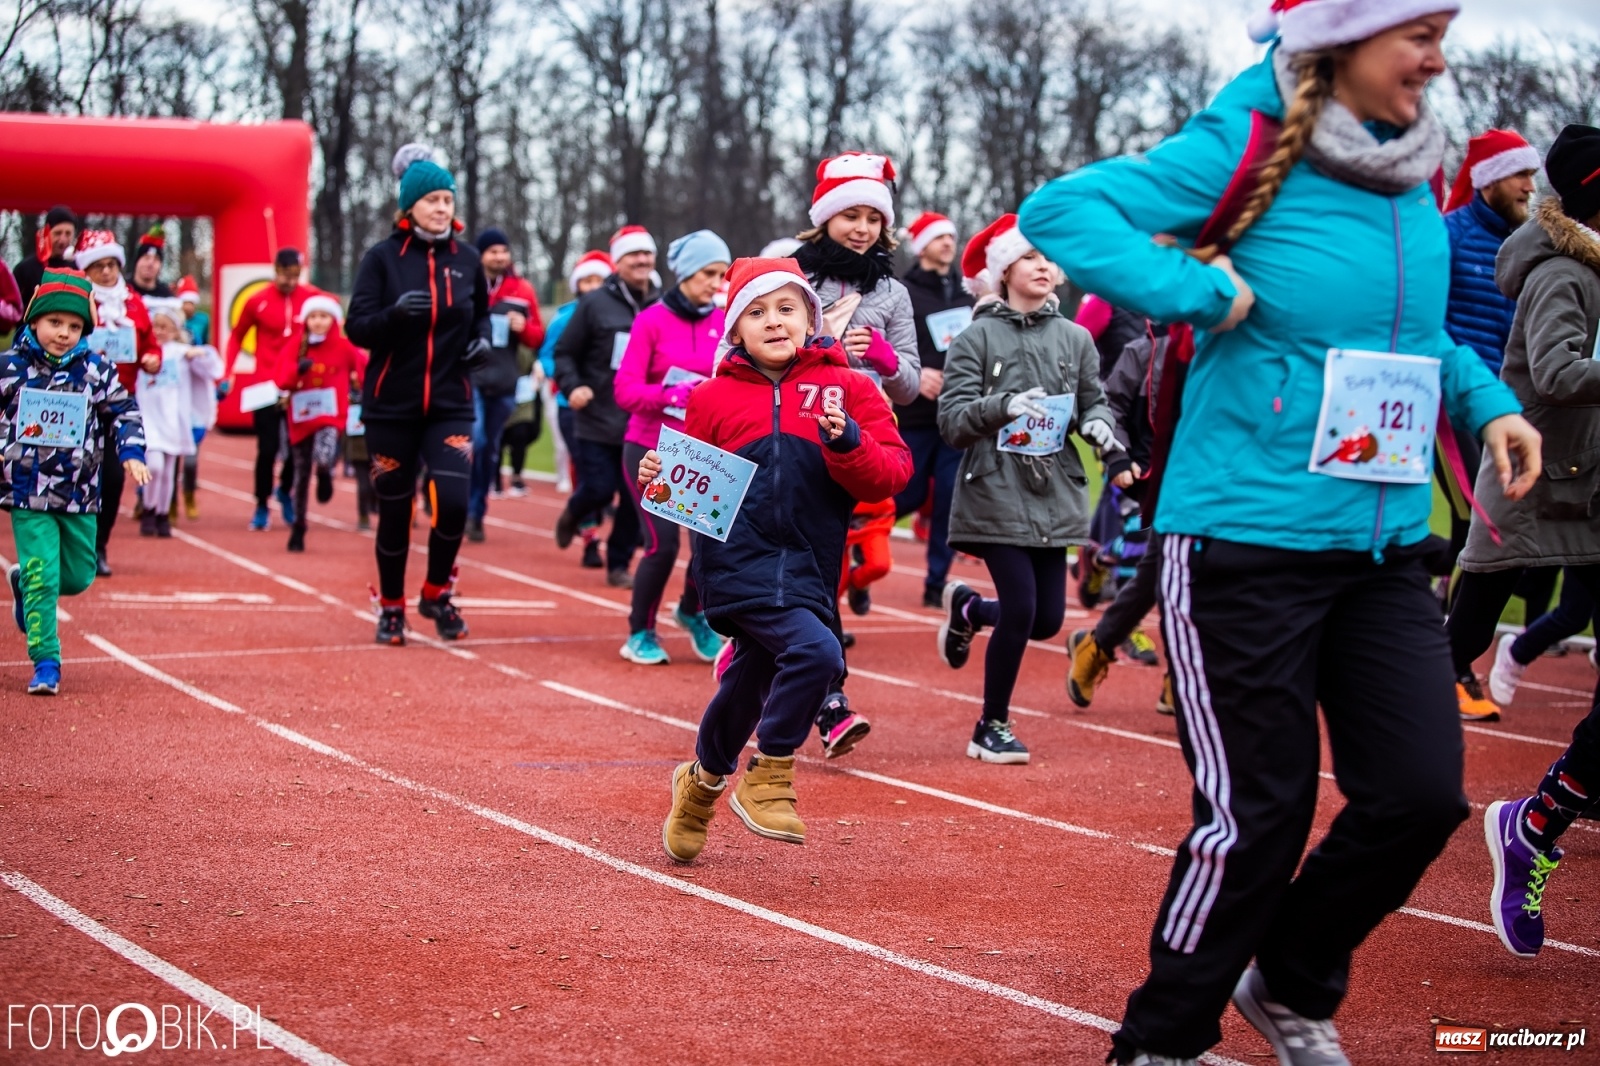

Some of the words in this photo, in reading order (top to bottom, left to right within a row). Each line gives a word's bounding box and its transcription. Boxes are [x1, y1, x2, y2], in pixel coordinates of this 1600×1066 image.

[797, 383, 845, 411] 78
[40, 409, 65, 425] 021
[1026, 416, 1055, 431] 046
[1379, 400, 1414, 431] 121
[670, 464, 711, 495] 076
